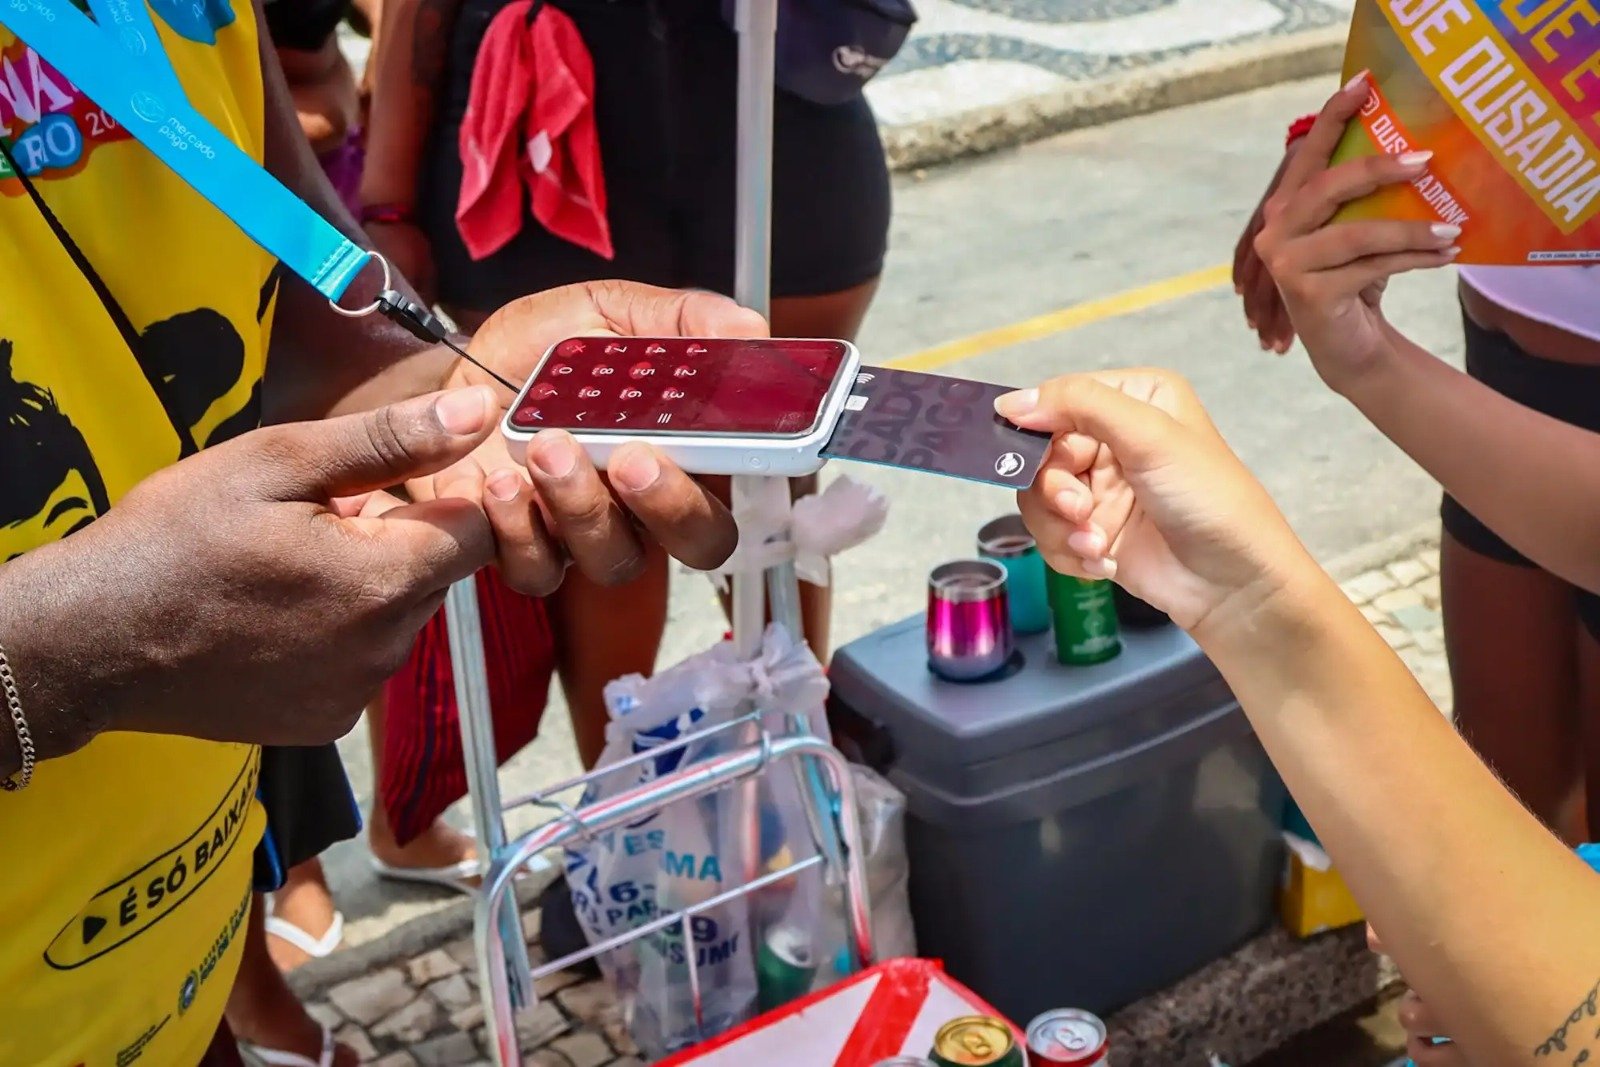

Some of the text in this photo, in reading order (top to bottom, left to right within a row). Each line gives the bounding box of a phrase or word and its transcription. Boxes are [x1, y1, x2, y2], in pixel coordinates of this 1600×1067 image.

[84, 109, 121, 137] 20
[1438, 35, 1600, 223] OUSADIA
[158, 125, 188, 151] pago
[168, 117, 215, 160] mercado
[652, 346, 667, 354] 4
[558, 366, 573, 375] 0
[599, 367, 614, 375] 8
[640, 368, 656, 376] 5
[681, 368, 697, 376] 2
[586, 389, 601, 397] 9
[627, 390, 643, 398] 6
[669, 391, 685, 399] 3
[664, 851, 722, 883] MA
[119, 886, 138, 927] É
[146, 855, 187, 909] SÓ
